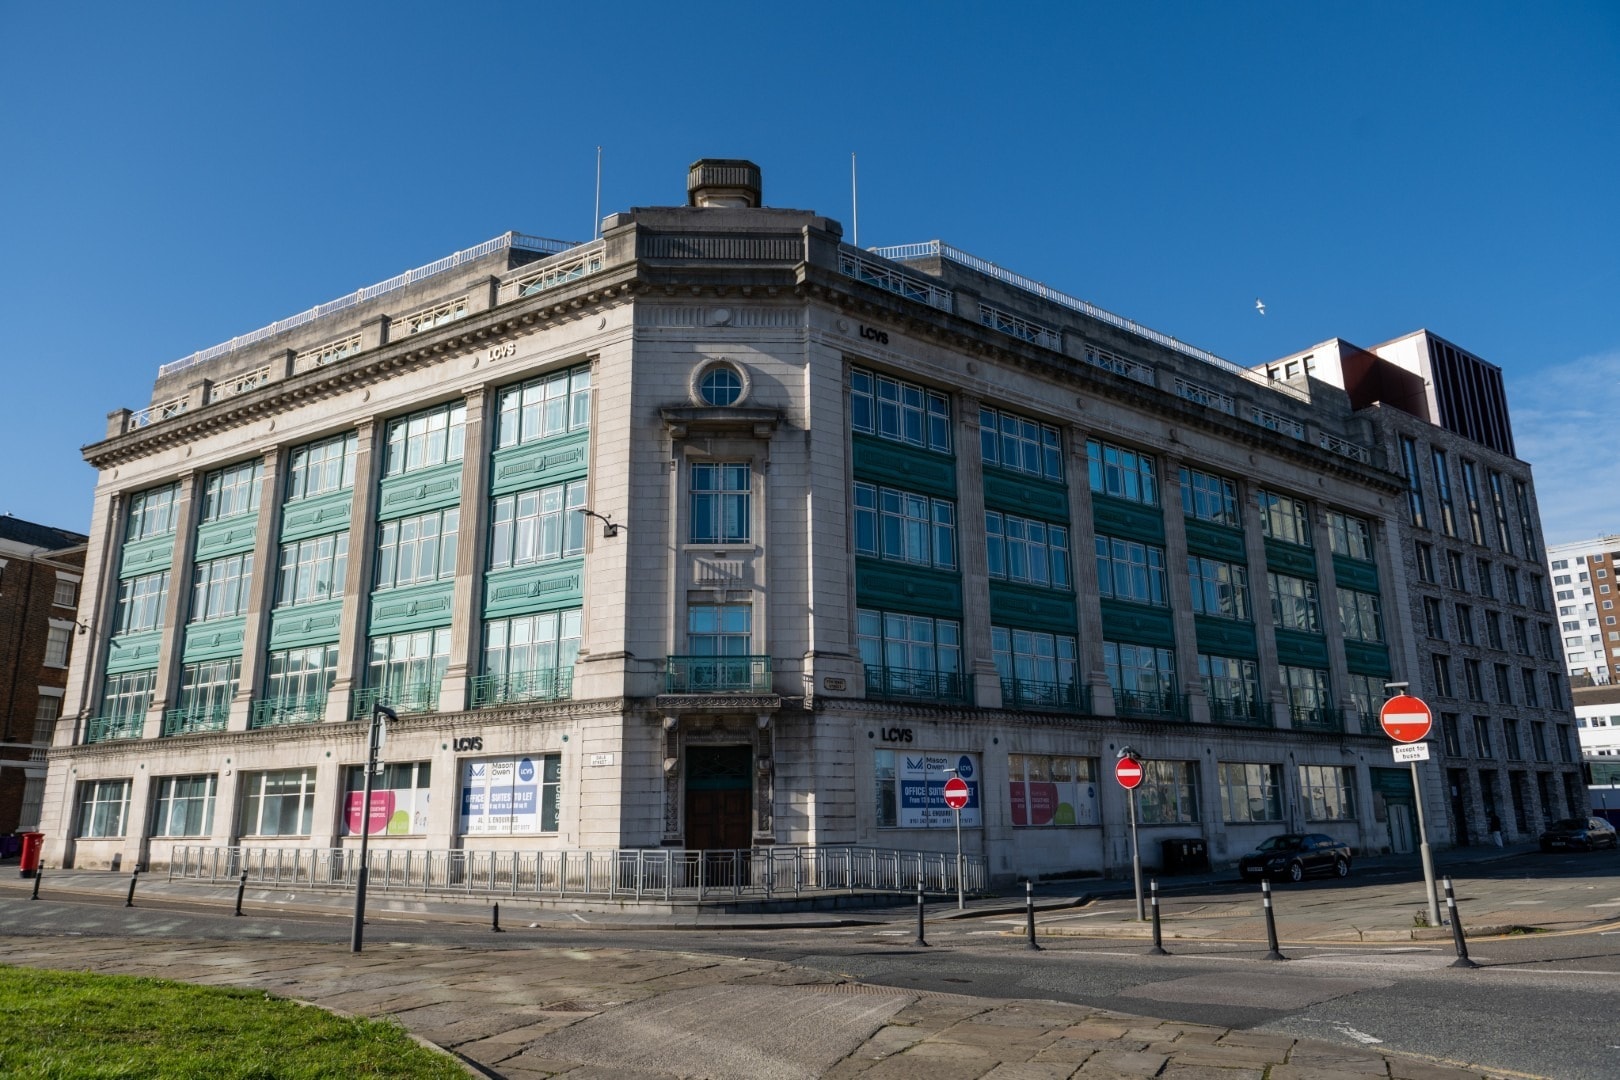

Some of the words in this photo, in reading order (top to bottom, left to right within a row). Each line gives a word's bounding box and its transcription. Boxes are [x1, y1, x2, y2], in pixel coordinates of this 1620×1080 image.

[860, 324, 888, 345] LCVS
[488, 343, 516, 362] LCVS
[882, 728, 913, 742] LCVS
[453, 736, 483, 752] LCVS
[466, 794, 484, 802] OFFICE
[491, 792, 510, 802] SUITES
[514, 792, 522, 800] TO
[522, 792, 533, 800] LET
[904, 787, 925, 796] OFFICE
[929, 787, 944, 796] SUITE
